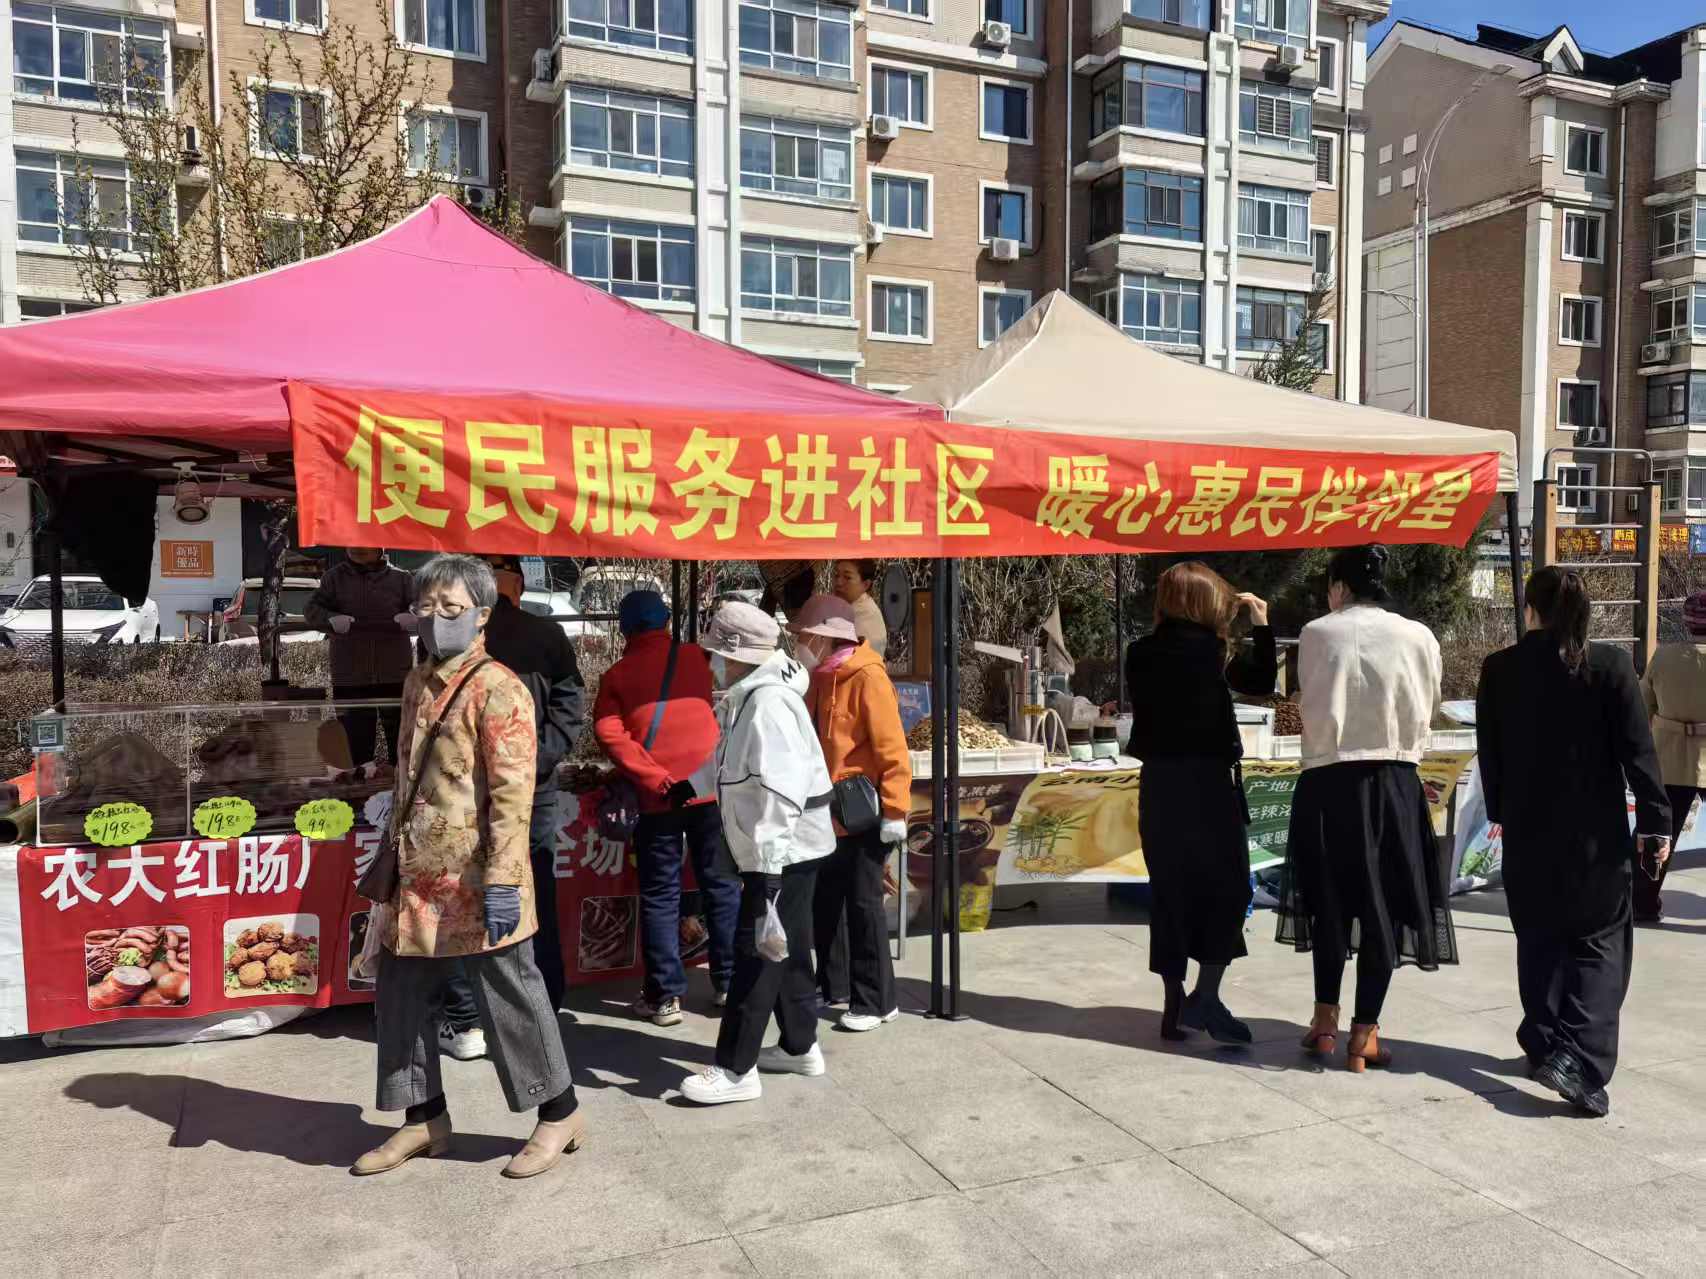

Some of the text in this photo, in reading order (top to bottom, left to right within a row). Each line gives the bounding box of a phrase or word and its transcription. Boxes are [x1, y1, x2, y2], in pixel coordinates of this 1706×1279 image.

[346, 405, 1473, 541] 便民服务进社区 暖心惠民伴邻里
[1246, 780, 1297, 793] 产地
